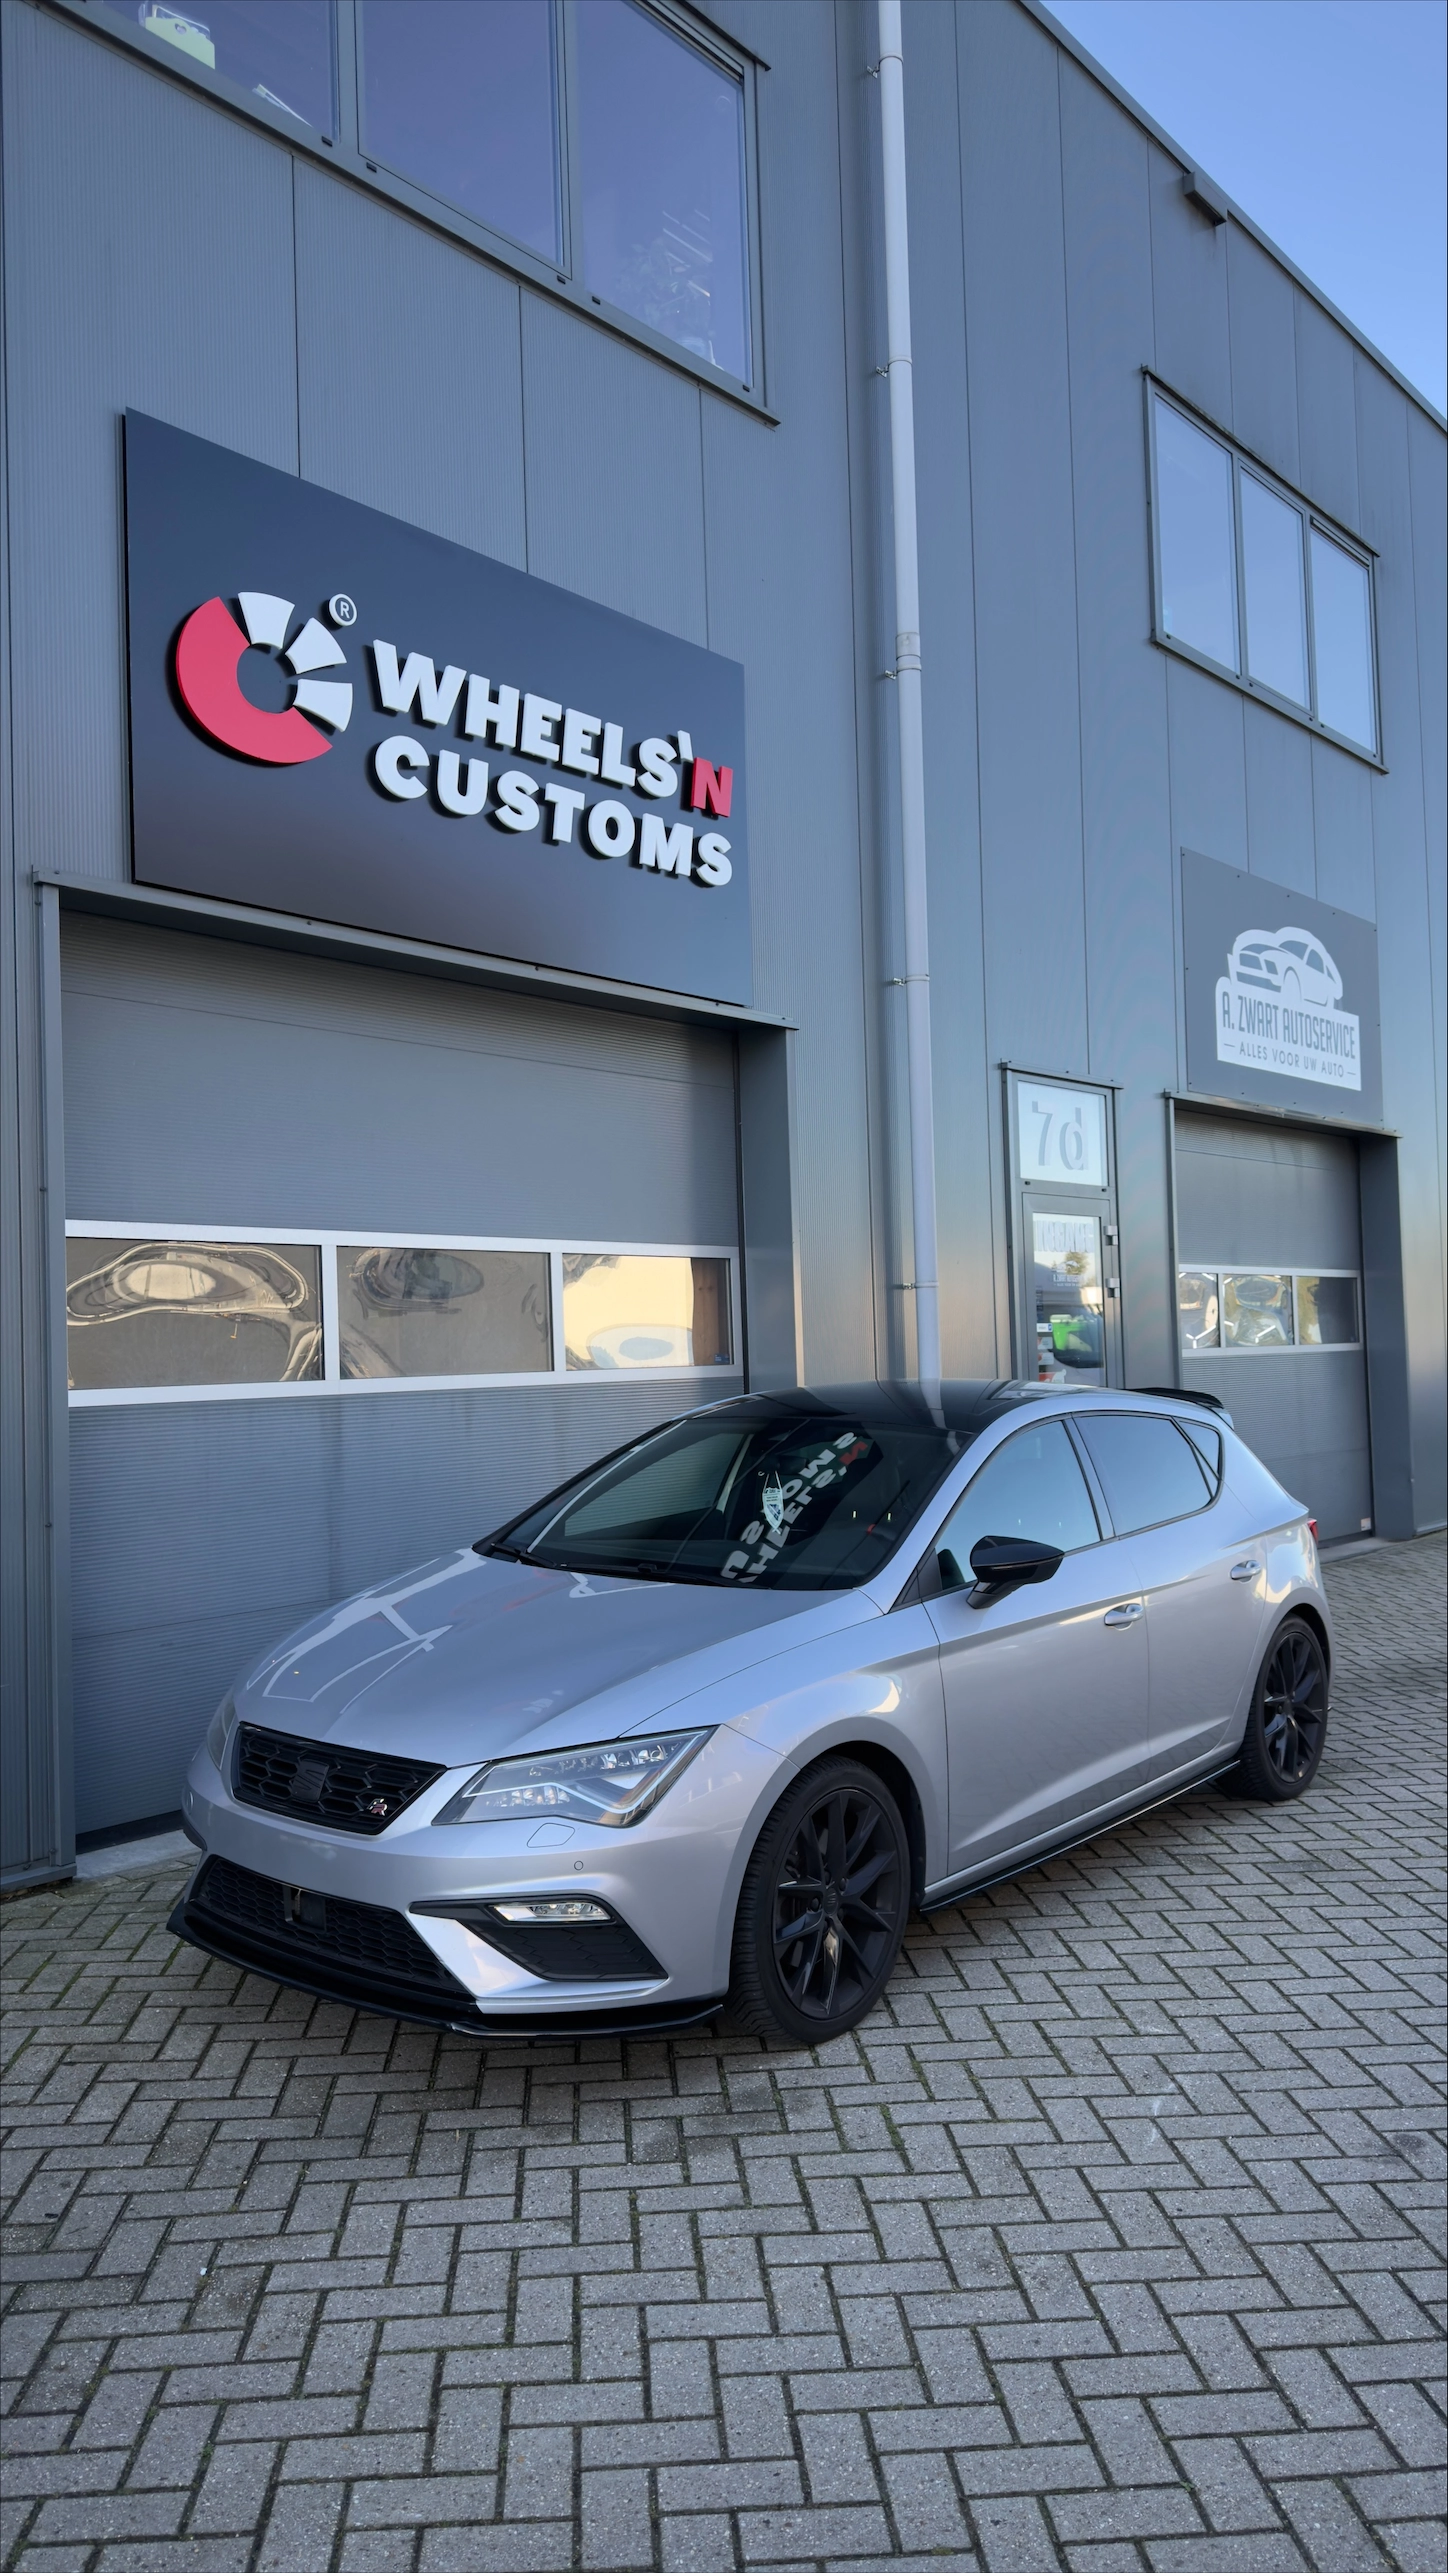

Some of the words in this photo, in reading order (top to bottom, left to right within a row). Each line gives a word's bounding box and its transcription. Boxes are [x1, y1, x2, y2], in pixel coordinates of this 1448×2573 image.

[375, 735, 732, 886] CUSTOMS
[1222, 991, 1235, 1030] A.
[1238, 995, 1279, 1040] ZWART
[1282, 1008, 1356, 1060] AUTOSERVICE
[1240, 1041, 1268, 1061] ALLES
[1272, 1048, 1300, 1068] VOOR
[1304, 1055, 1318, 1071] UW
[1321, 1061, 1345, 1078] AUTO
